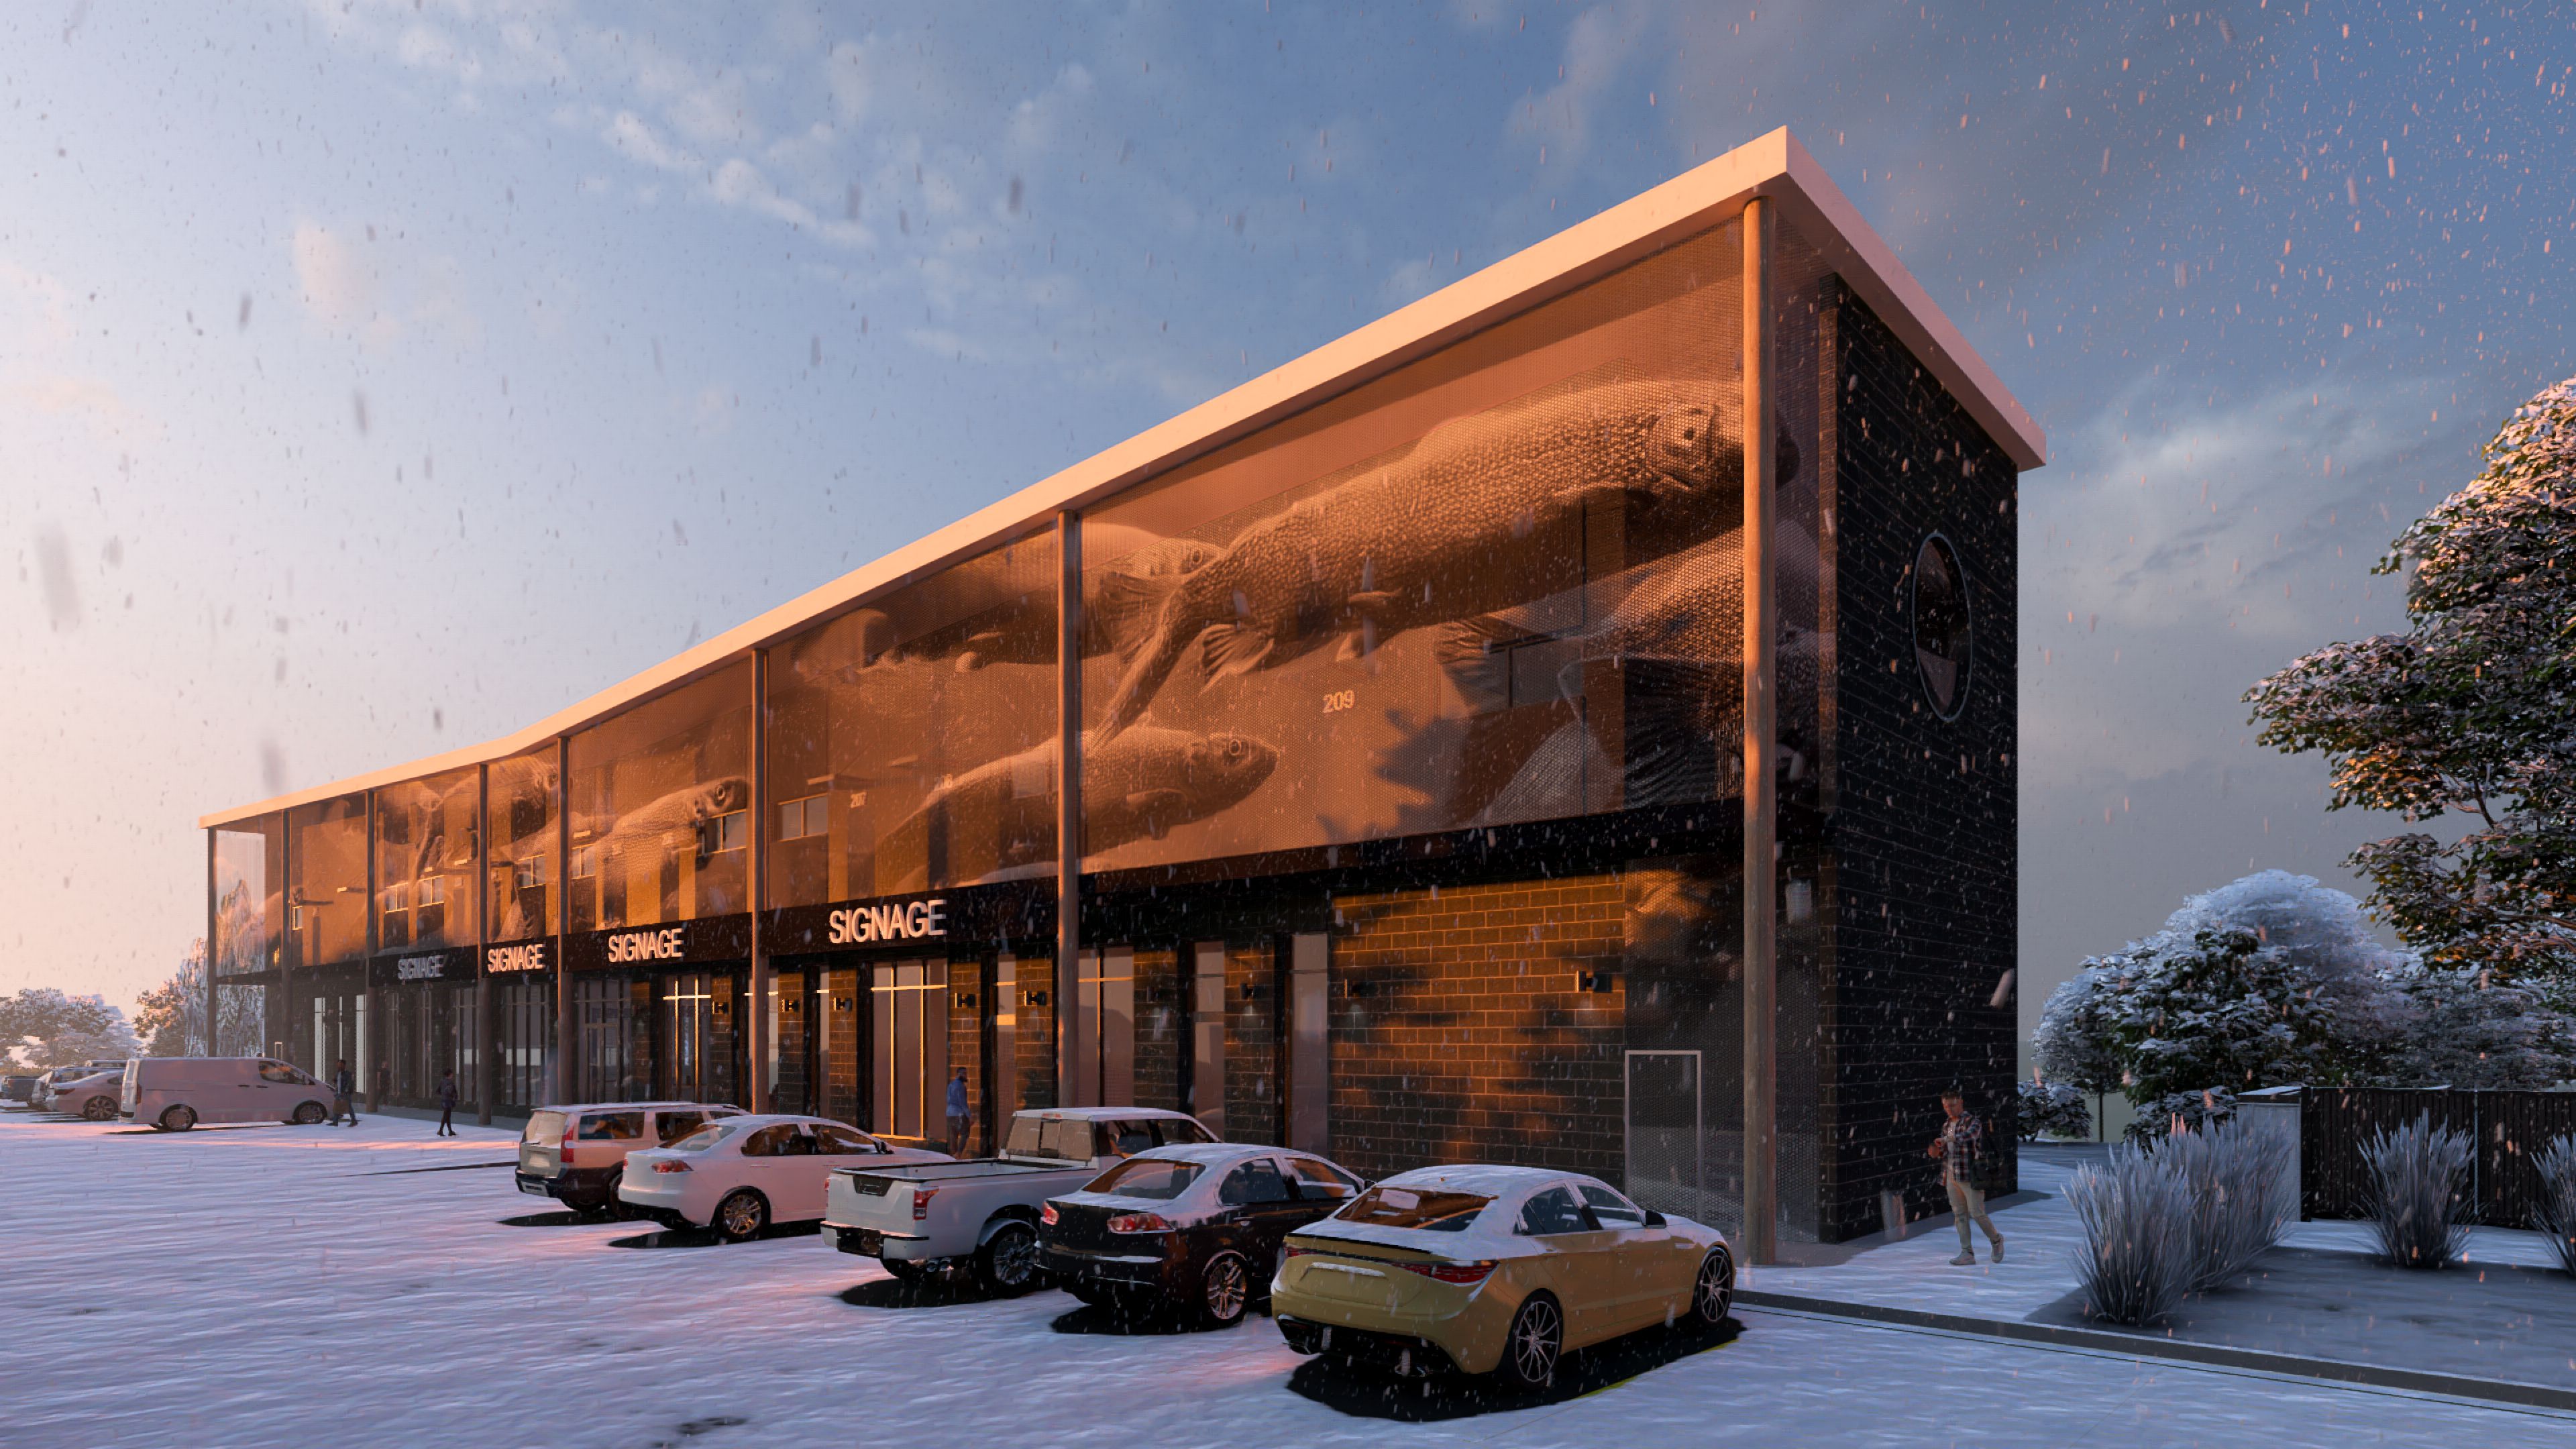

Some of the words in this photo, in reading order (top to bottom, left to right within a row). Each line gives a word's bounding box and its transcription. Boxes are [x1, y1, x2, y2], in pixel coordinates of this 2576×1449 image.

[1323, 690, 1354, 713] 209
[828, 899, 947, 944] SIGNAGE
[488, 944, 545, 973] SIGNAGE
[608, 928, 684, 962] SIGNAGE
[398, 955, 443, 979] SIGNAGE
